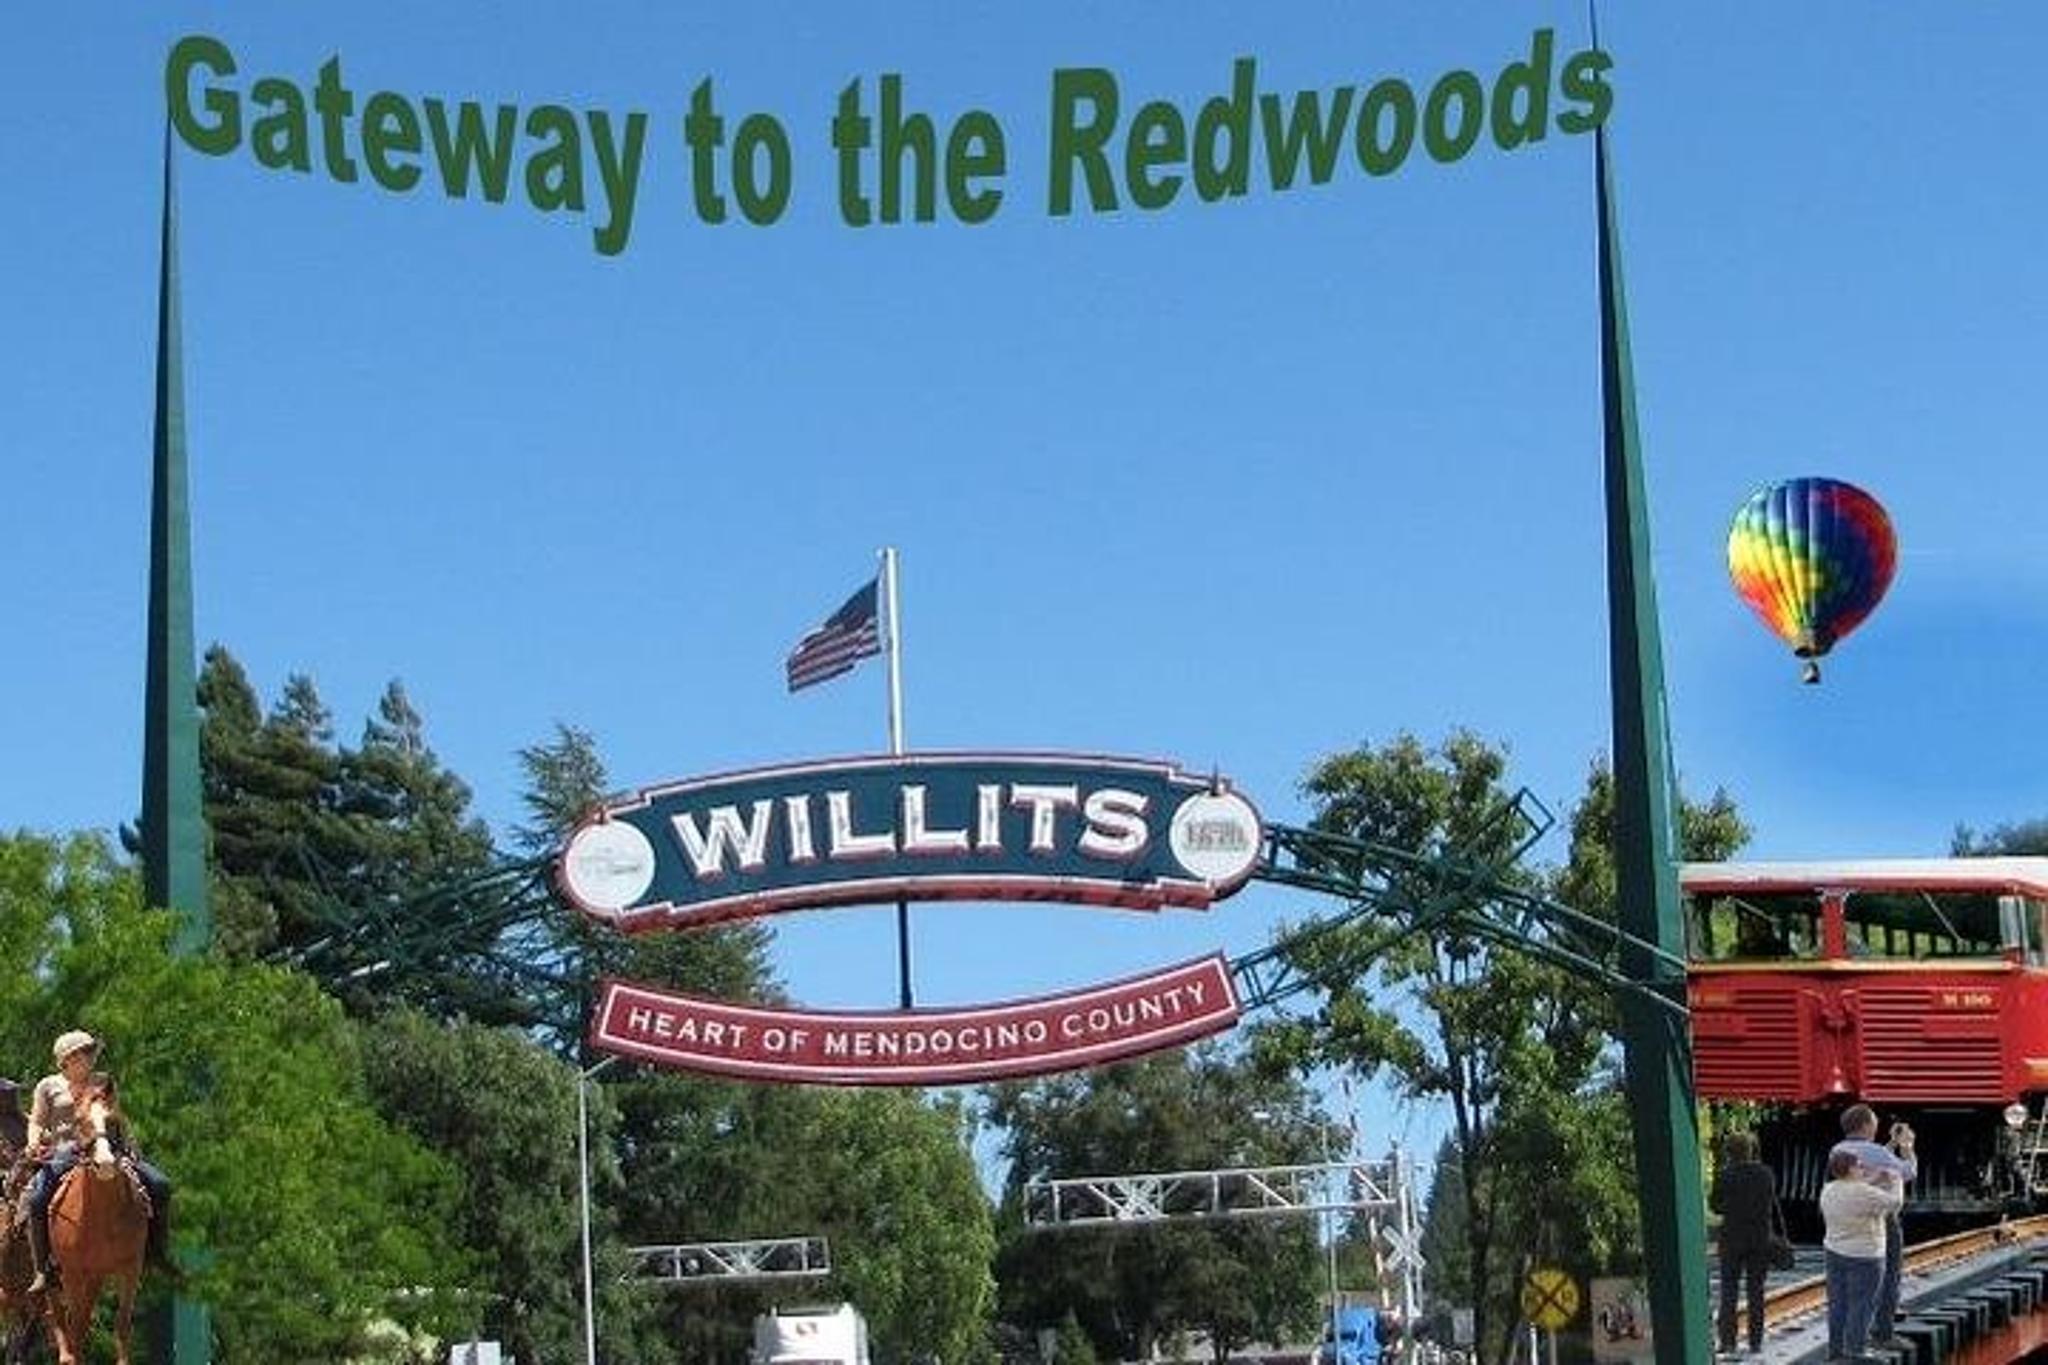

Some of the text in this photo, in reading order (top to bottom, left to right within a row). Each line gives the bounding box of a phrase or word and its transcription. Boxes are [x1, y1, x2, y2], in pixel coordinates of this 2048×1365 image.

[671, 783, 1150, 879] WILLITS
[627, 981, 1205, 1056] HEART OF MENDOCINO COUNTY
